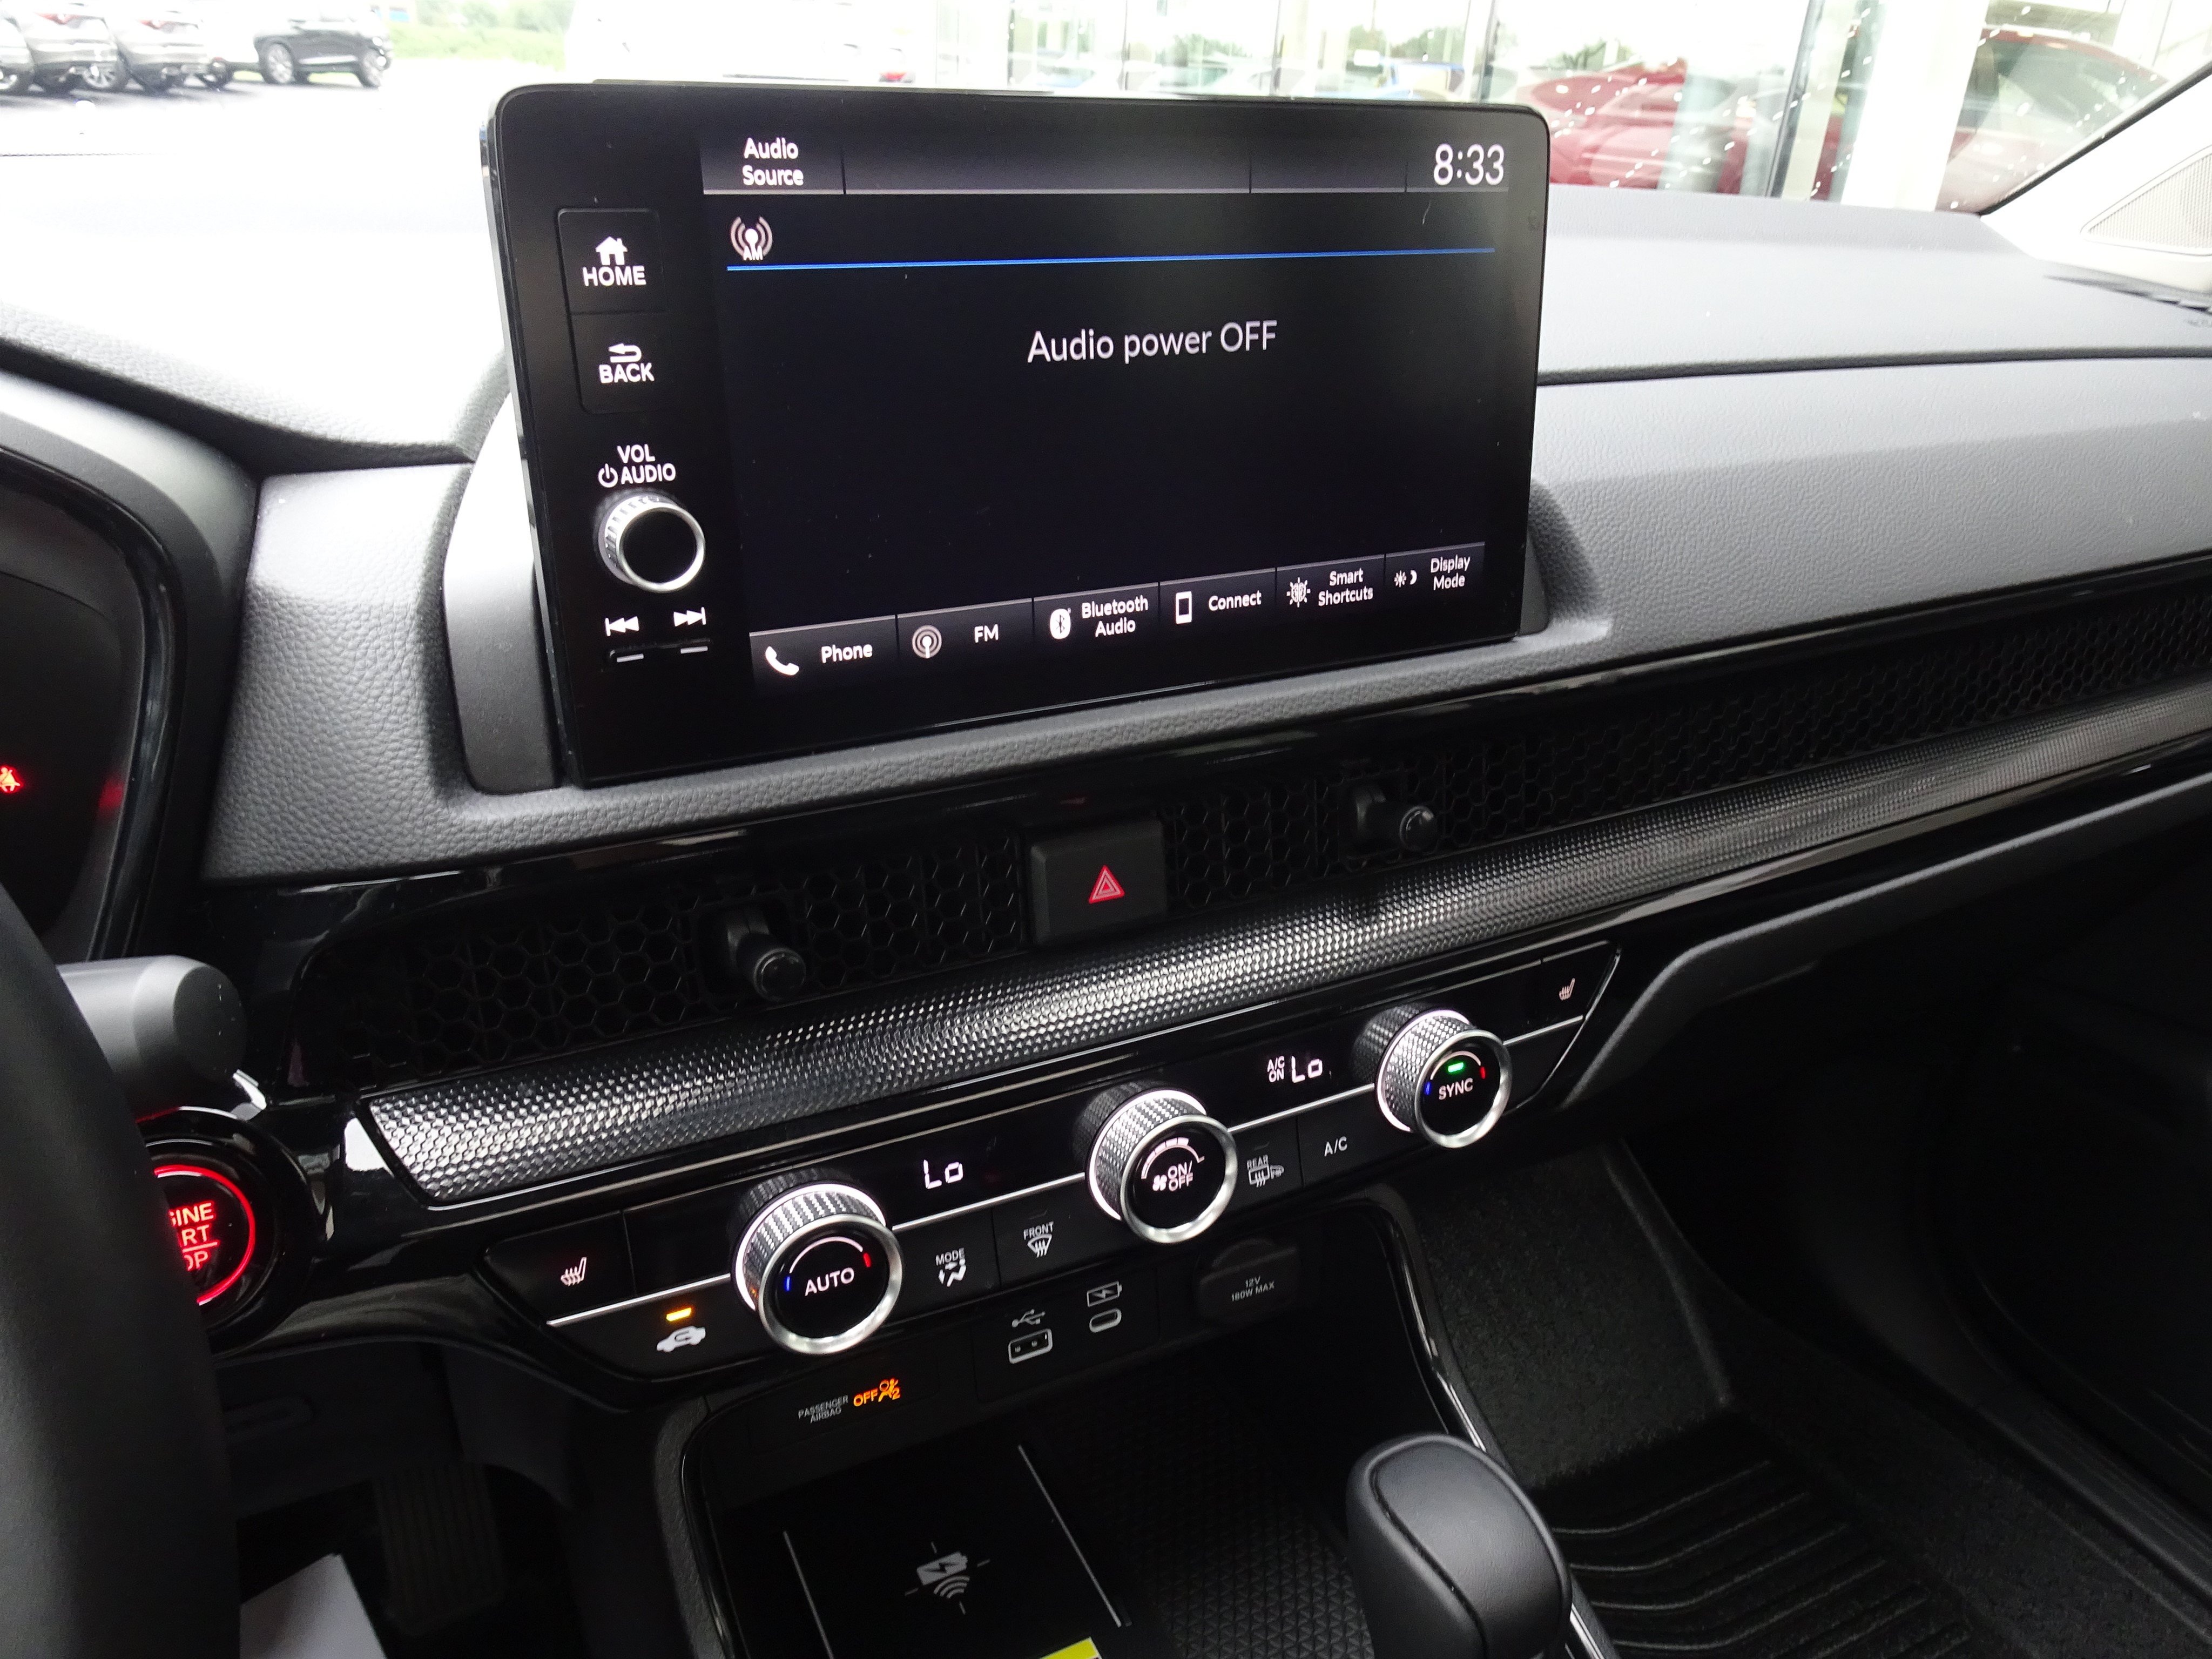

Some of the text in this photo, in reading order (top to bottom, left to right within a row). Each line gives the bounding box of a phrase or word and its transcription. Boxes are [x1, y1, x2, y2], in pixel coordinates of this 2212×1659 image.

[743, 138, 799, 159] Audio
[1433, 143, 1505, 186] 8:33
[742, 165, 804, 186] Source
[743, 245, 763, 261] AM
[582, 265, 646, 287] HOME
[1027, 320, 1277, 364] Audio power OFF
[599, 362, 655, 383] BACK
[617, 443, 656, 464] VOL
[621, 463, 676, 485] AUDIO
[1431, 554, 1471, 574] Display
[1329, 568, 1364, 586] Smart
[1433, 573, 1465, 590] Mode
[1208, 590, 1262, 611] Connect
[1318, 586, 1373, 606] Shortcuts
[1081, 594, 1149, 619] Bluetooth
[974, 624, 999, 643] FM
[1095, 618, 1136, 637] Audio
[820, 644, 873, 664] Phone
[1267, 1055, 1285, 1073] A/C
[1269, 1068, 1285, 1083] ON
[1439, 1077, 1473, 1100] SYNC
[1324, 1136, 1347, 1157] A/C
[1168, 1160, 1192, 1179] ON/
[1246, 1155, 1269, 1170] REAR
[1168, 1171, 1193, 1192] OFF
[1023, 1220, 1054, 1240] FRONT
[935, 1247, 965, 1266] MODE
[805, 1267, 855, 1297] AUTO
[1245, 1276, 1260, 1287] 12V
[1256, 1281, 1274, 1294] MAX
[798, 1394, 848, 1419] PASSENGER
[853, 1387, 878, 1407] OFF
[810, 1407, 842, 1424] AIRBAG
